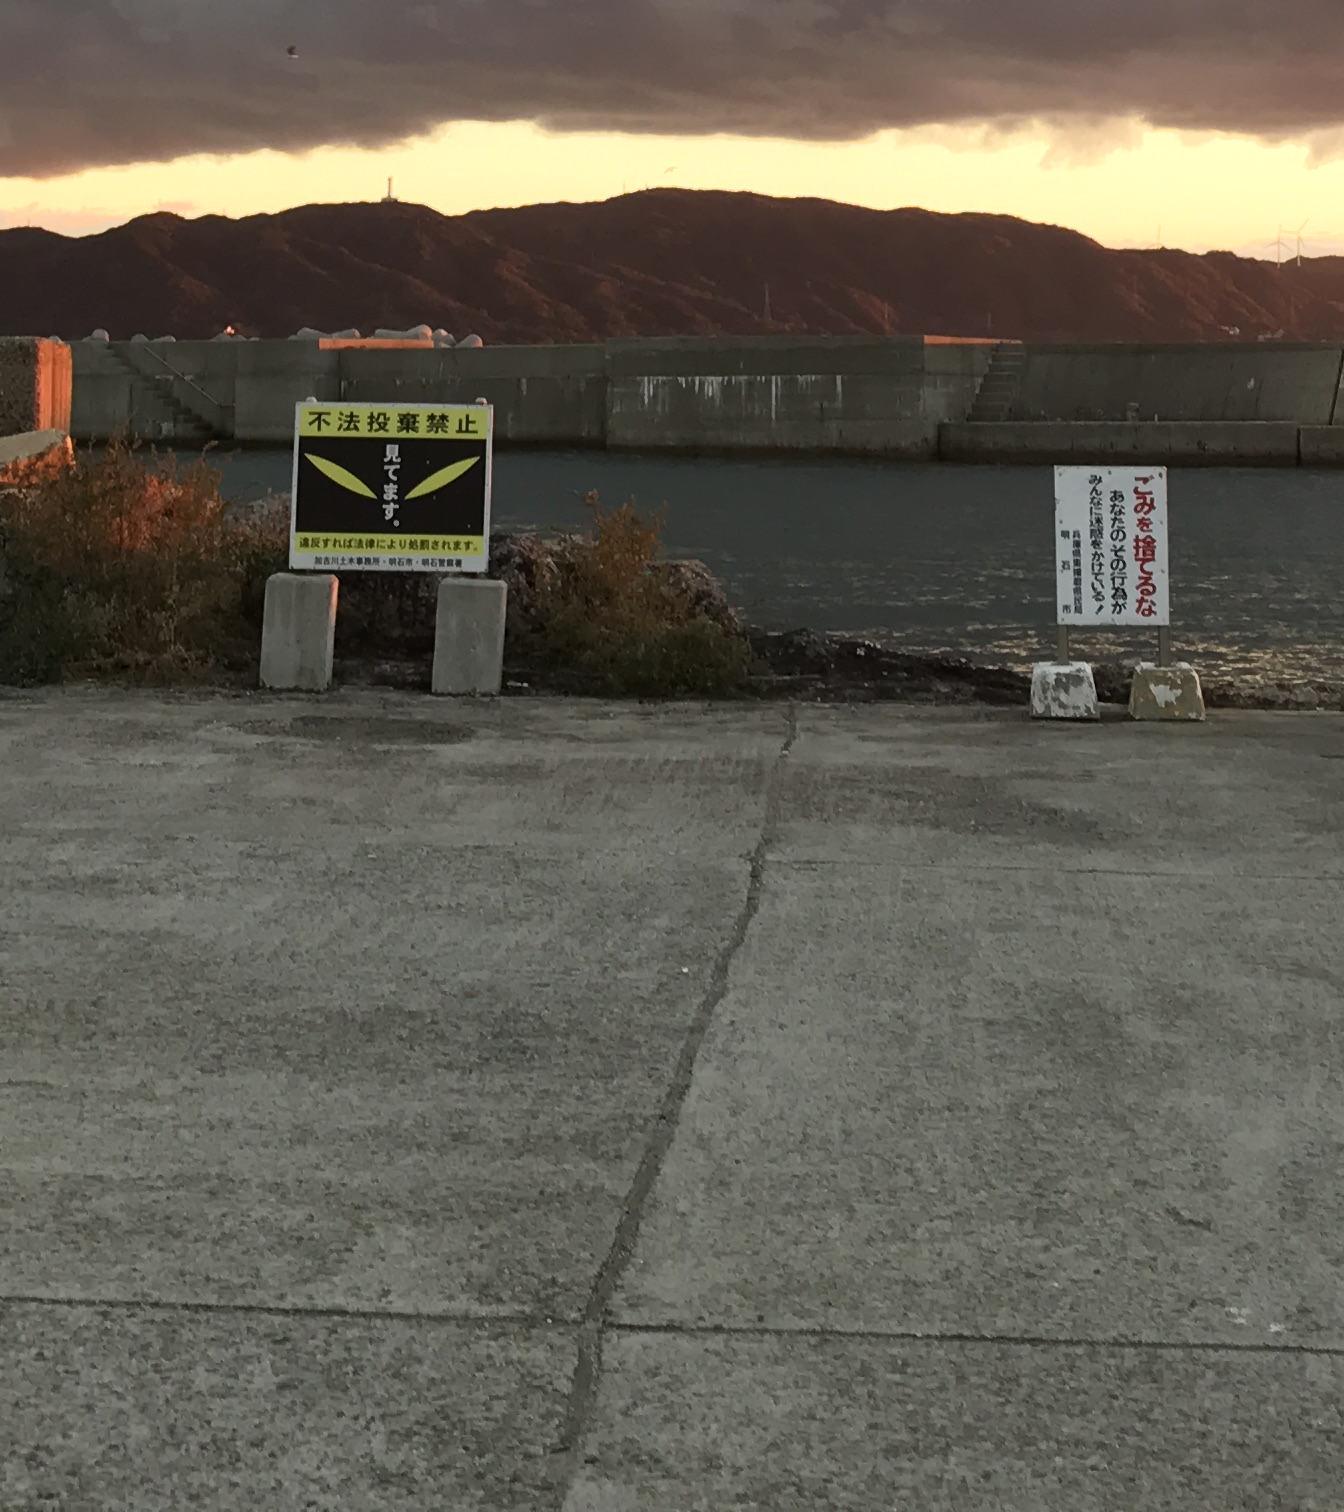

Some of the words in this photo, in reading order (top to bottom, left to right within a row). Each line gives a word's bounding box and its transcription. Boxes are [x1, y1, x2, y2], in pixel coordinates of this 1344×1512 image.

[308, 411, 479, 434] 不法投棄禁止
[382, 444, 402, 527] 見てます。
[1109, 490, 1128, 615] あなたのその行為が
[1132, 475, 1157, 618] ごみを捨てるな
